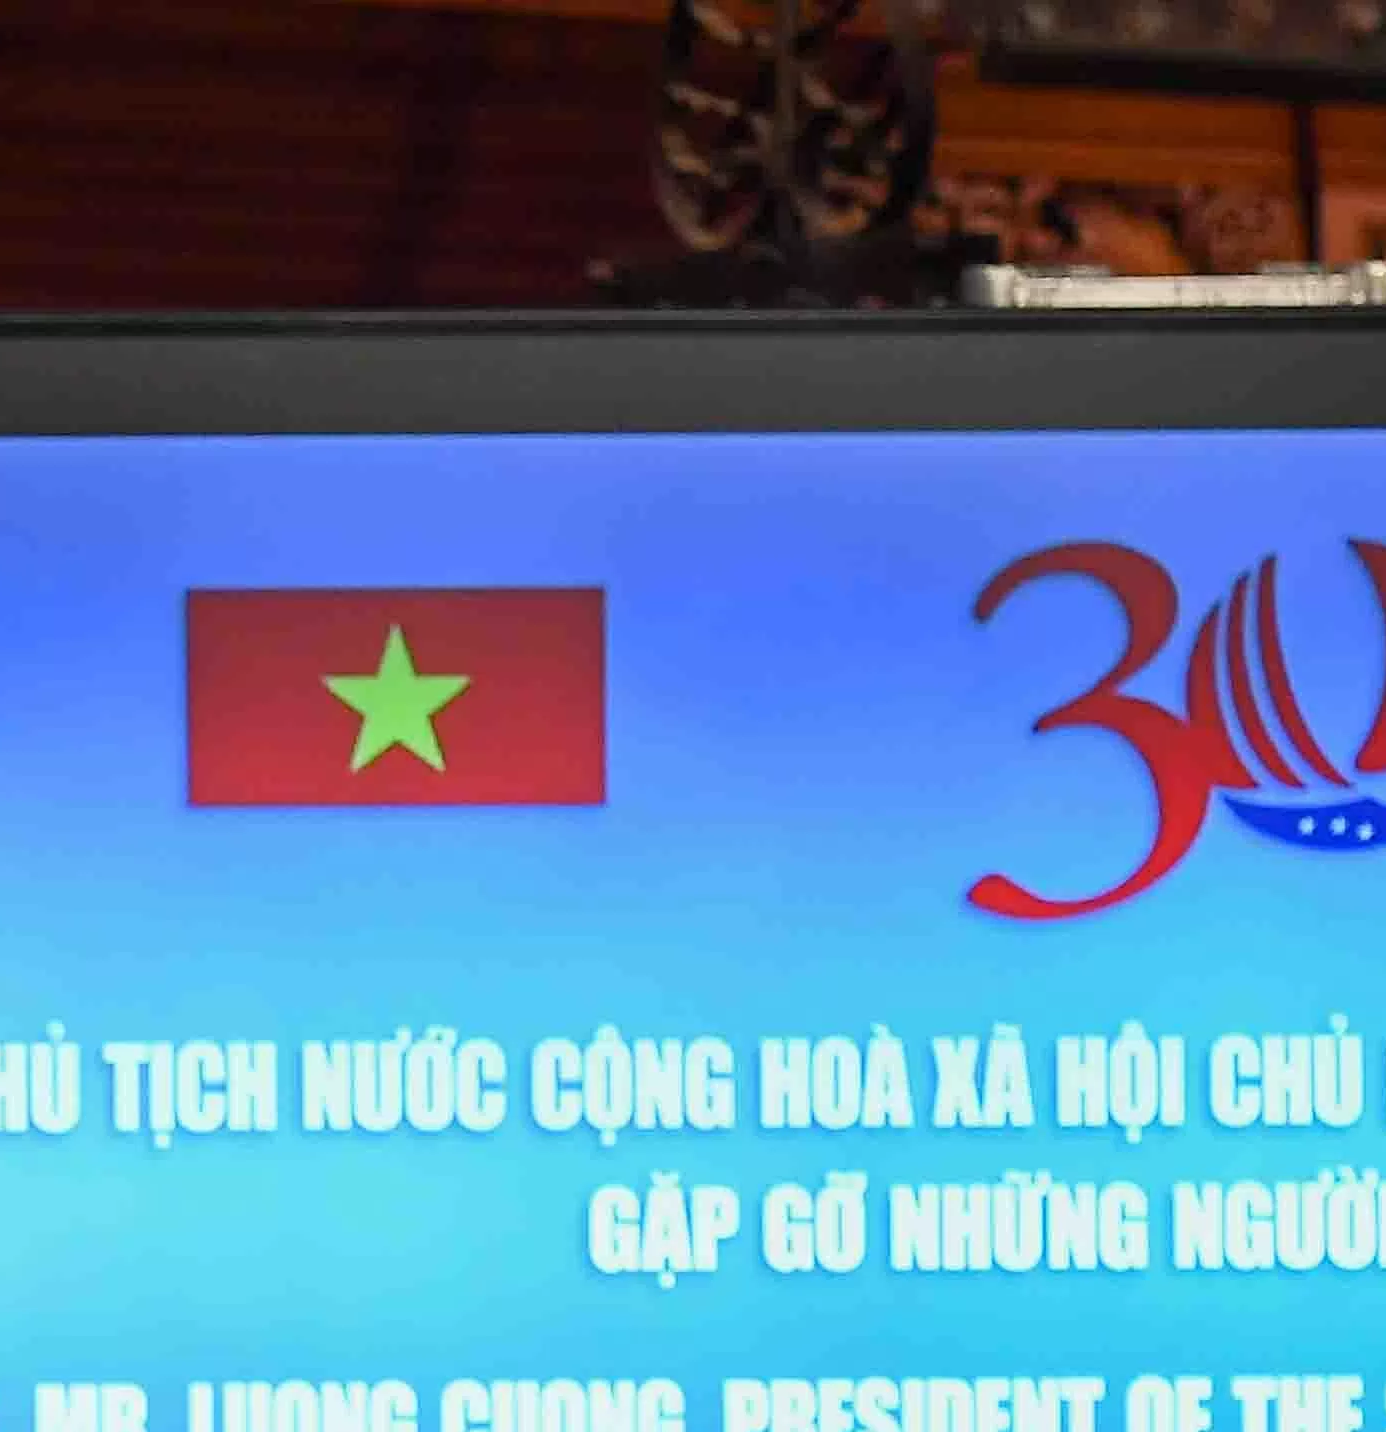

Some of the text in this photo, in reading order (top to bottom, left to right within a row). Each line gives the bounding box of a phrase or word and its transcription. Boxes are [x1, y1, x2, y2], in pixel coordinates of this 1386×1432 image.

[102, 1041, 278, 1149] TỊCH
[303, 1027, 506, 1131] NƯỚC
[532, 1025, 735, 1146] CỘNG
[761, 1023, 913, 1128] HOÀ
[933, 1022, 1034, 1127] XÃ
[1057, 1020, 1186, 1143] HỘI
[1211, 1013, 1364, 1127] CHỦ
[589, 1171, 740, 1289] GẶP
[763, 1171, 868, 1273] GỠ
[890, 1170, 1150, 1271] NHỮNG
